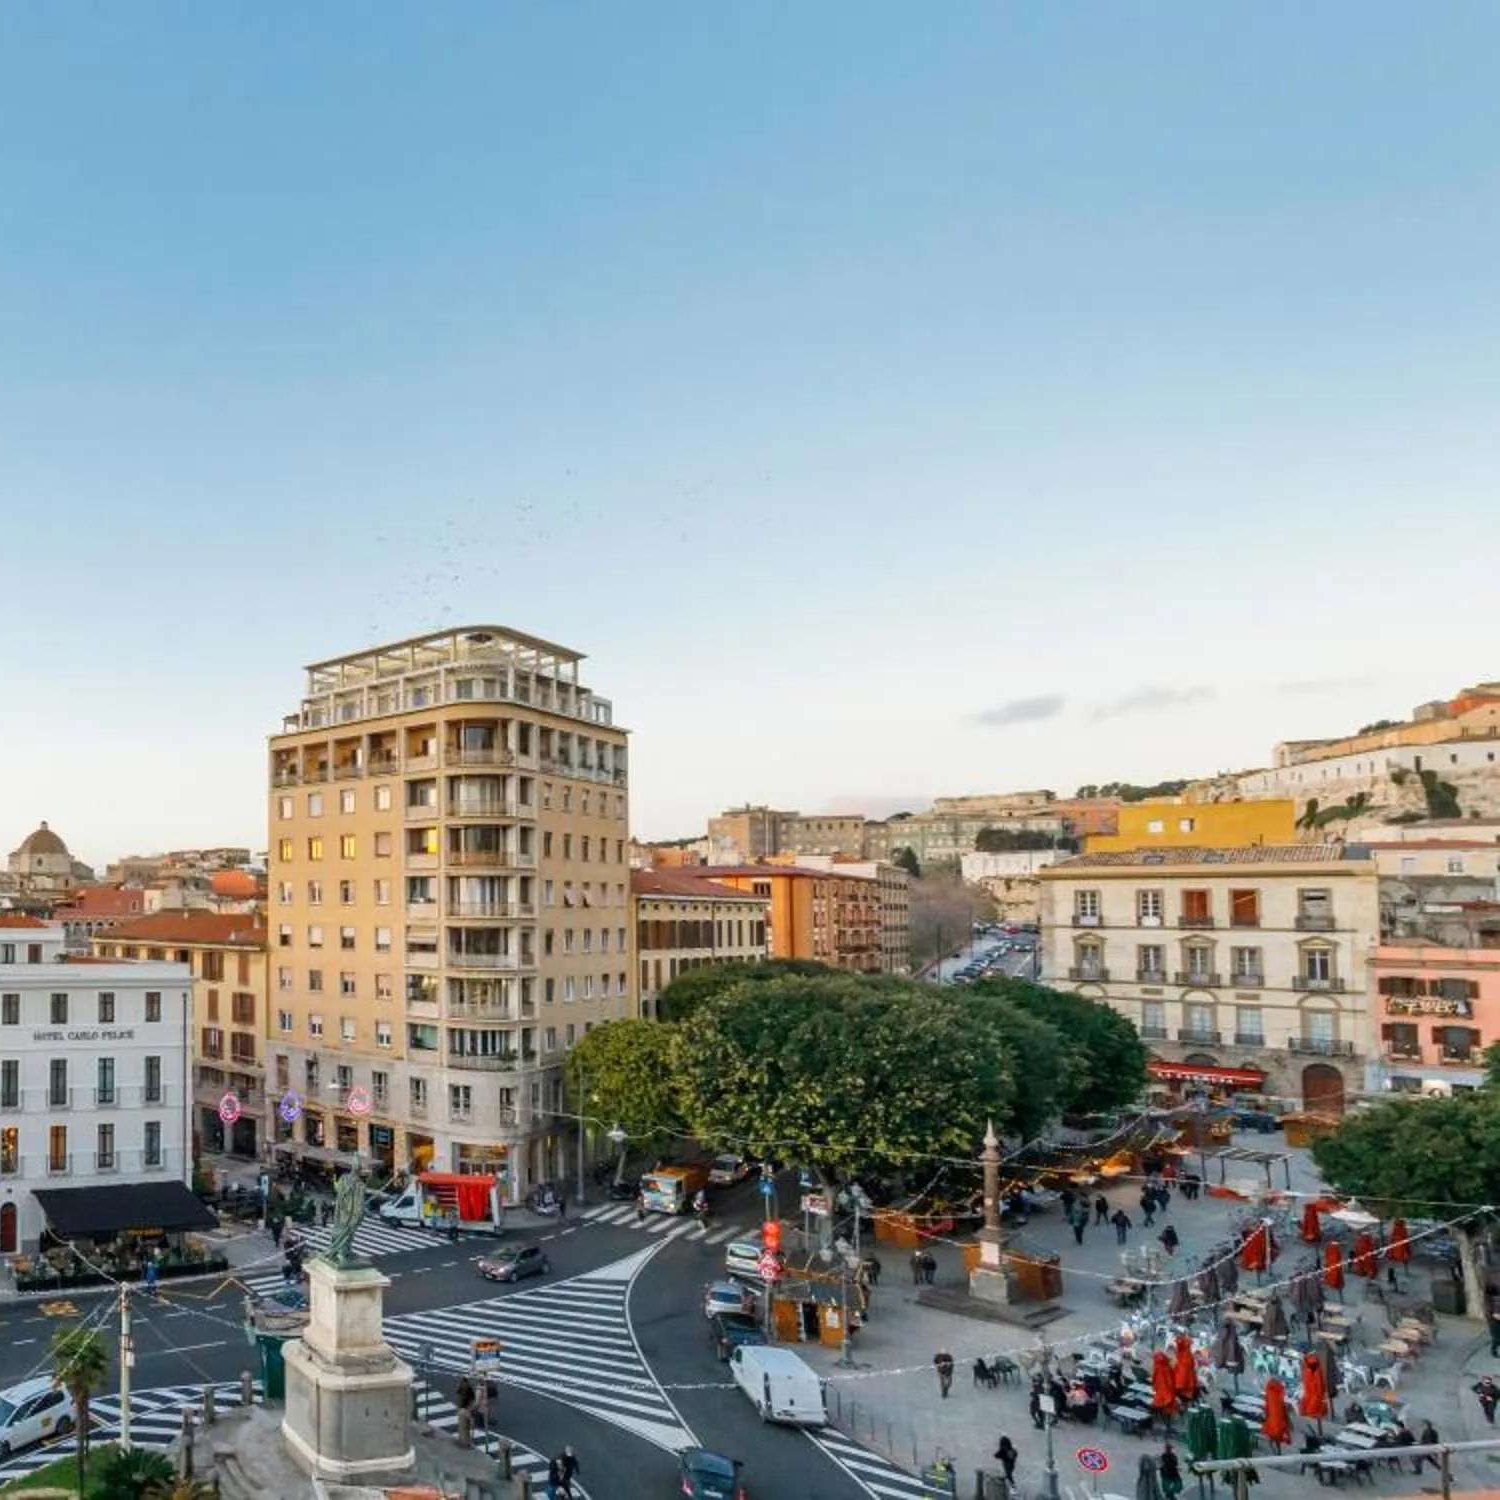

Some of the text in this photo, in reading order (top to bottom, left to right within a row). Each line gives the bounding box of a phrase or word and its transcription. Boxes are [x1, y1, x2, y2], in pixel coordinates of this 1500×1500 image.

[33, 1030, 134, 1041] HOTEL CARLO FELICE
